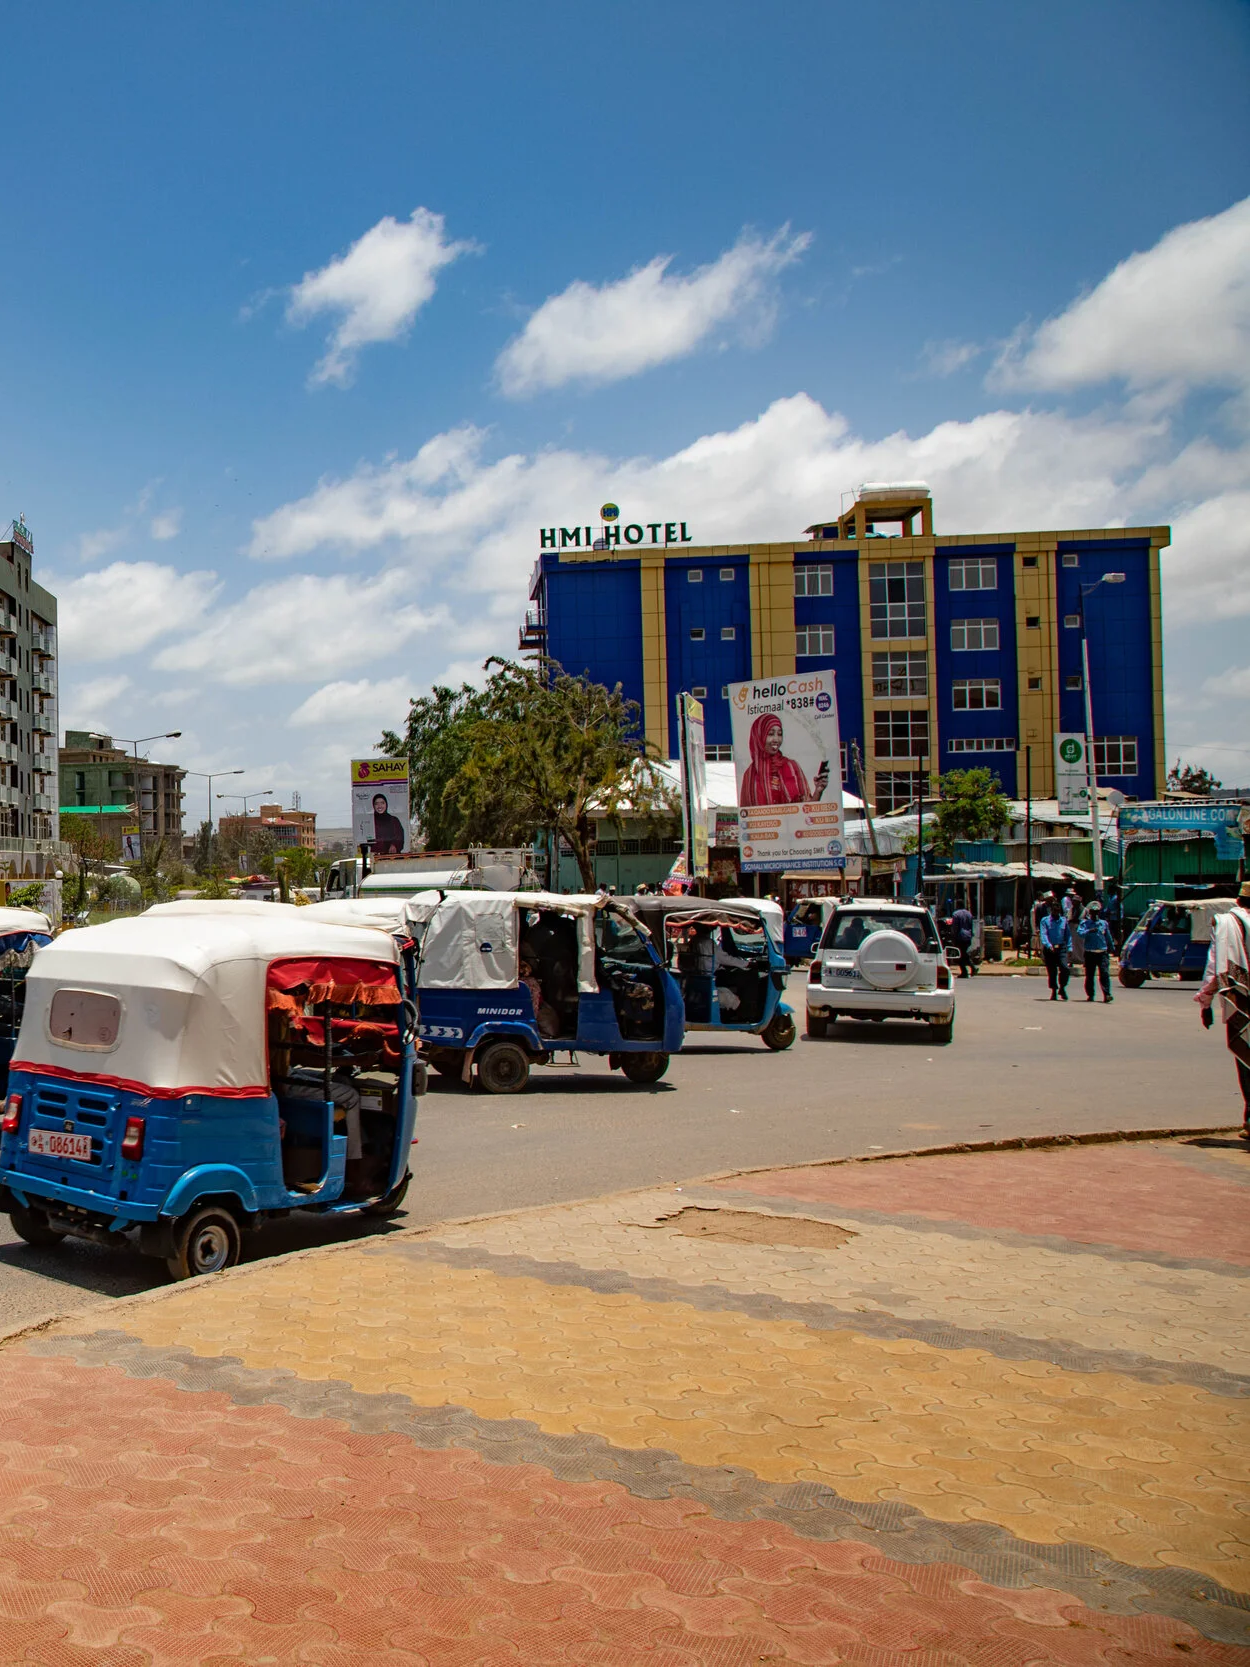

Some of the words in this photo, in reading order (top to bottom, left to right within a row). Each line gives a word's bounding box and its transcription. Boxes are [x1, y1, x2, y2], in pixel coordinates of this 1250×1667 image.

[540, 526, 592, 548] HMI
[604, 522, 692, 546] HOTEL
[753, 677, 823, 699] helloCash
[747, 699, 784, 715] Isticmaal
[373, 762, 406, 773] SAHAY
[772, 849, 781, 857] you
[789, 847, 812, 856] Choosing
[477, 1007, 523, 1016] MINIDOR
[49, 1135, 82, 1156] 08614
